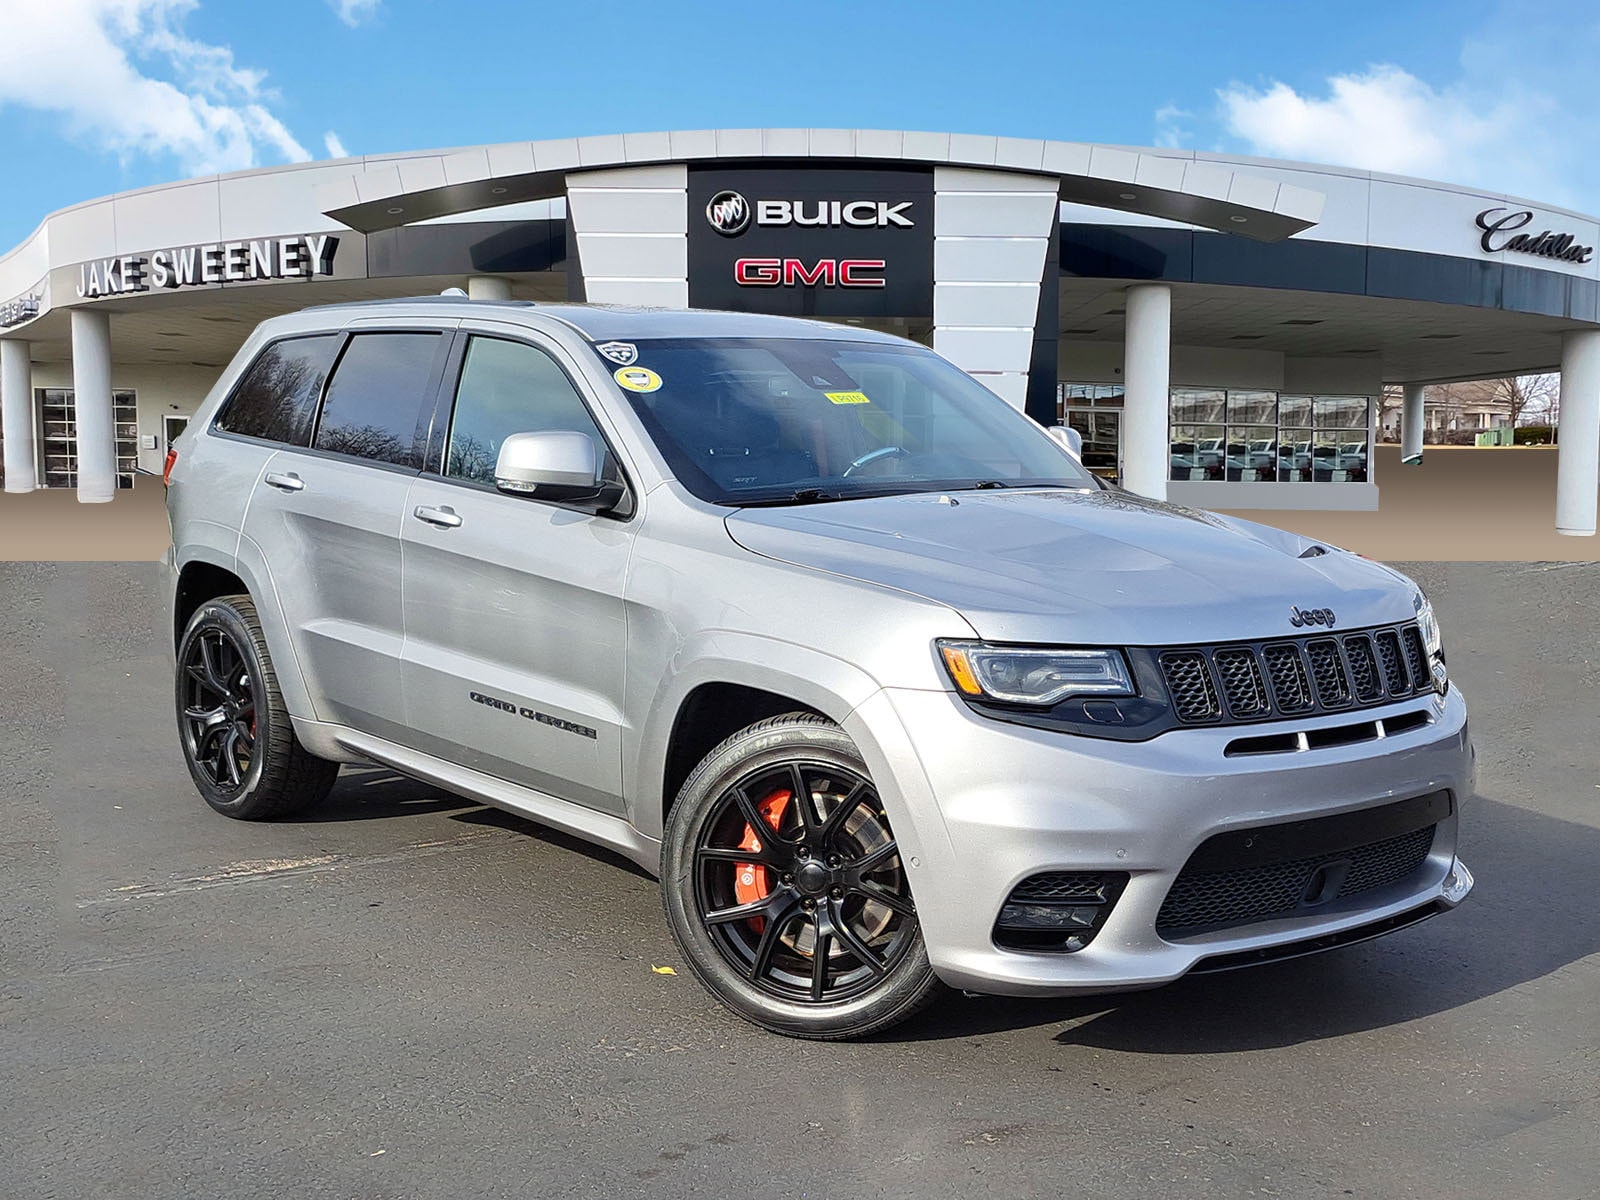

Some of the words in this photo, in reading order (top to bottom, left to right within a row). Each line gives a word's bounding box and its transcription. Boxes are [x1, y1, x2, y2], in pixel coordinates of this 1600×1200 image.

[757, 200, 915, 226] BUICK
[1475, 207, 1593, 264] Cadillac
[76, 255, 142, 298] JAKE
[151, 235, 335, 288] SWEENEY
[735, 258, 886, 287] GMC
[1289, 606, 1336, 628] Jeep
